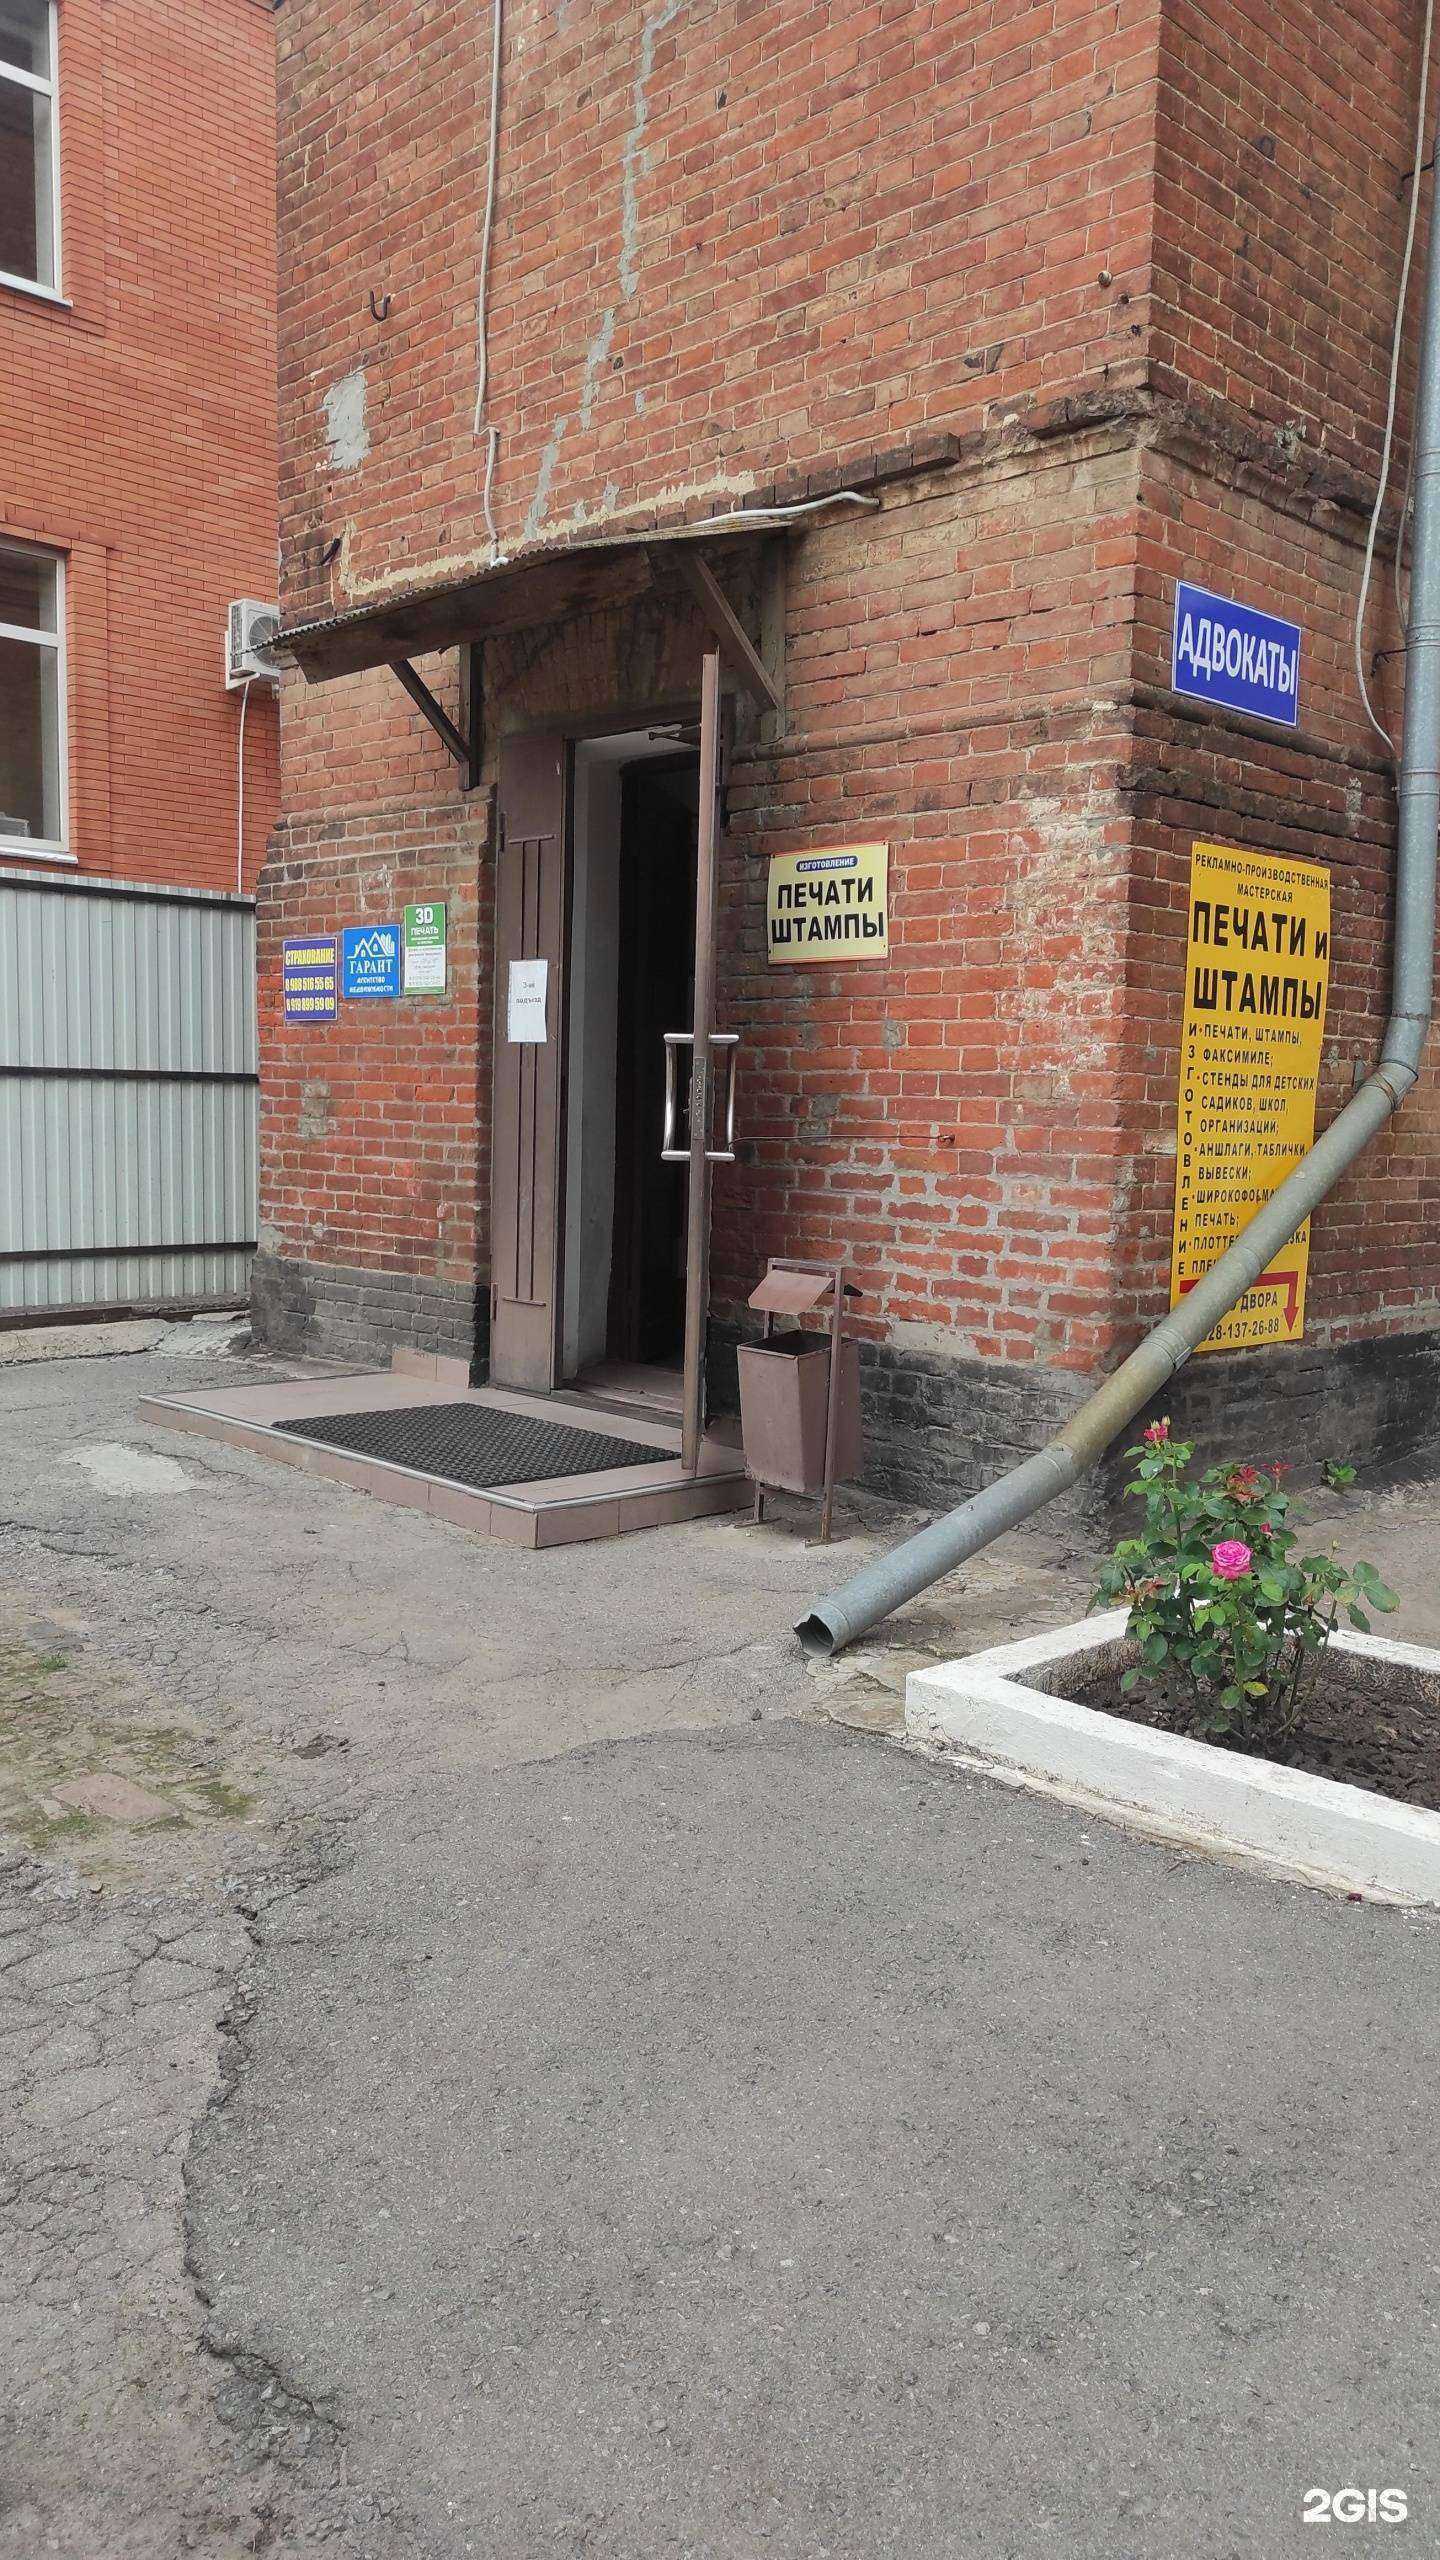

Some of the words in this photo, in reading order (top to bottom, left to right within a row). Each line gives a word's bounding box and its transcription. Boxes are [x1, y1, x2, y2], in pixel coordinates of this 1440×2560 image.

[1178, 612, 1297, 696] АДВОКАТЫ
[799, 857, 855, 871] ИЗГОТОВЛЕНИЕ
[1195, 853, 1329, 891] РЕКЛАМНО-ПРОИЗВОДСТВЕННАЯ
[777, 876, 874, 909] ПЕЧАТИ
[1237, 883, 1293, 904] МАСТЕРСКАЯ
[415, 906, 434, 925] 3D
[410, 926, 439, 936] ПЕЧАТЬ
[771, 911, 884, 943] ШТАМПЫ
[1192, 900, 1306, 957] ПЕЧАТИ
[285, 947, 335, 966] СТРАХОВАНИЕ
[350, 959, 393, 974] ГАРАНТ
[1193, 966, 1323, 1020] ШТАМПЫ
[1204, 1023, 1252, 1042] ПЕЧАТИ,
[1255, 1027, 1302, 1045] ШТАМПЫ,
[1203, 1047, 1274, 1067] ФАКСИМИЛЕ;
[1202, 1071, 1249, 1089] СТЕНДЫ
[1251, 1074, 1272, 1091] ДЛЯ
[1273, 1075, 1315, 1091] ДЕТСКИХ
[1201, 1095, 1256, 1113] САДИКОВ,
[1259, 1098, 1288, 1115] ШКОЛ,
[1199, 1143, 1254, 1158] АНШЛАГИ,
[1198, 1166, 1252, 1181] ВЫВЕСКИ;
[1194, 1212, 1240, 1228] ПЕЧАТЬ;
[1193, 1234, 1240, 1250] ПЛОТТЕ
[1191, 1258, 1217, 1274] ПЛЕ
[1240, 1291, 1278, 1314] ДВОРА
[1208, 1317, 1280, 1341] 28-137-26-88
